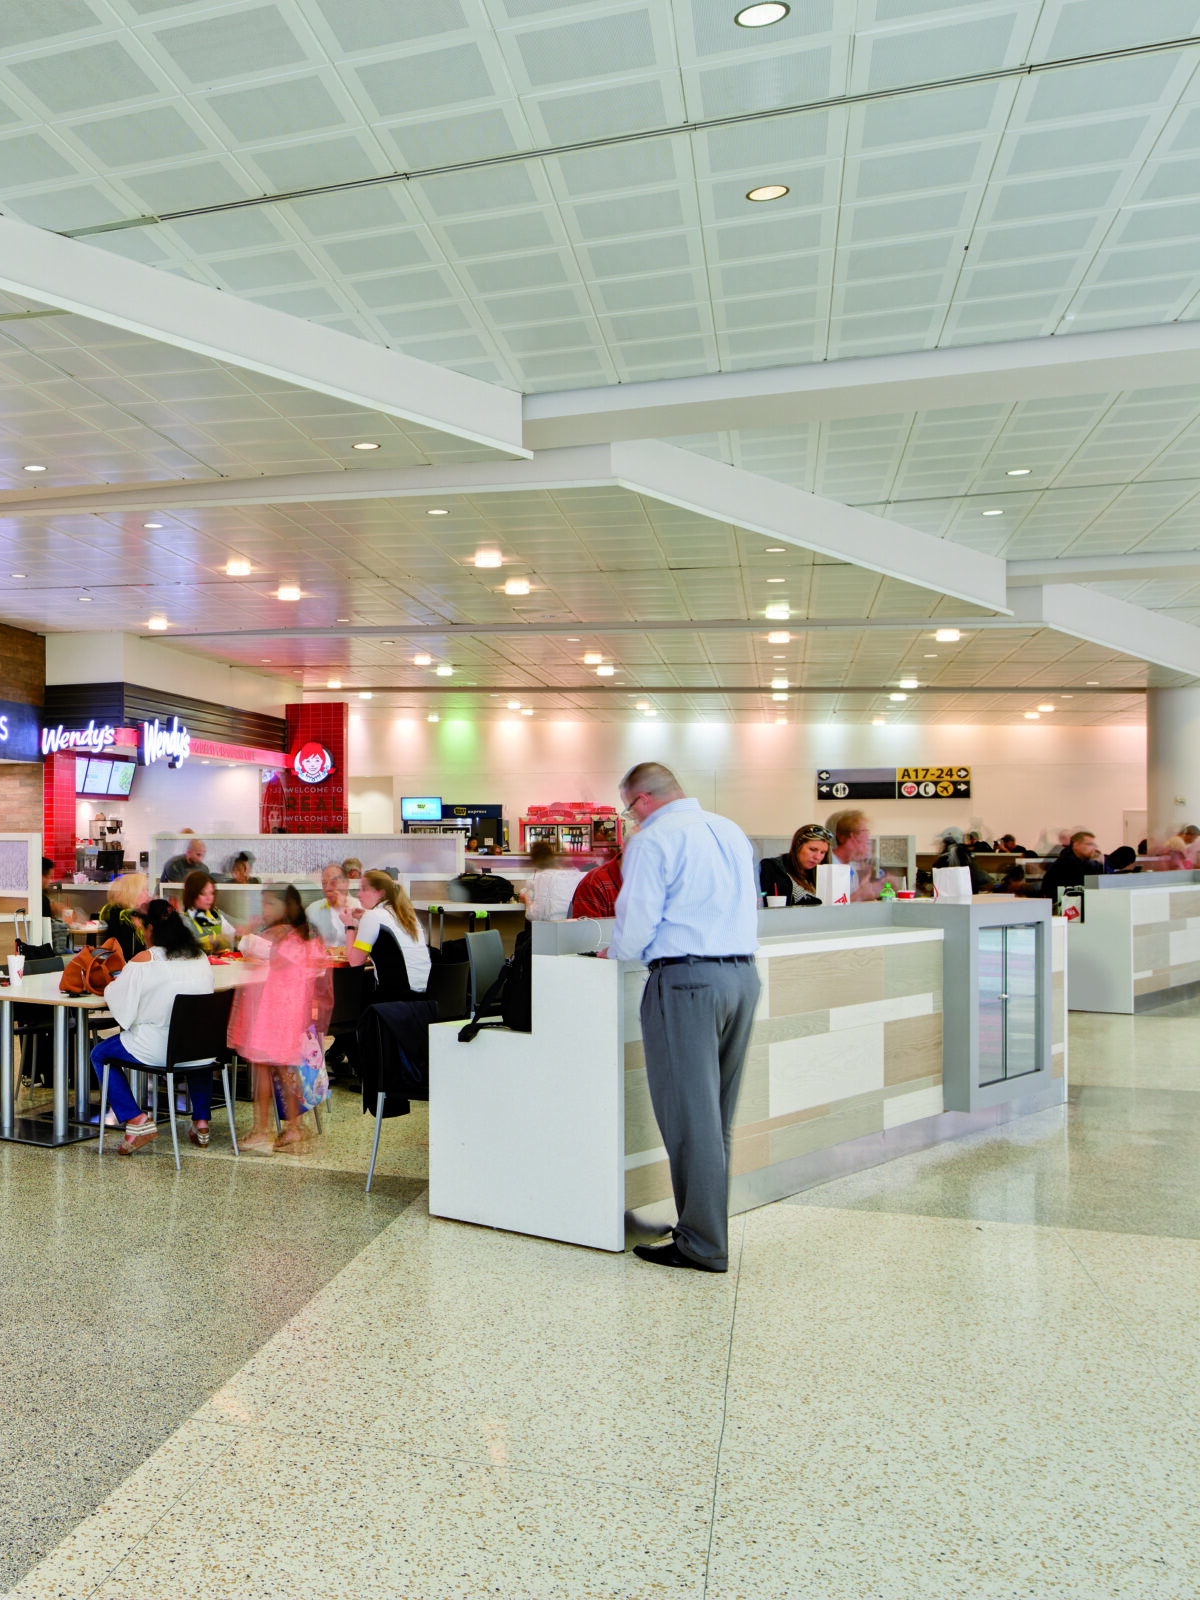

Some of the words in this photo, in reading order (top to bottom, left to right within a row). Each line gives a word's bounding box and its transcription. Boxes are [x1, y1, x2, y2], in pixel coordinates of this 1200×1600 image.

[41, 720, 116, 754] Wendy's
[143, 716, 191, 768] Wendy's
[901, 768, 954, 779] A17-24
[287, 797, 342, 812] REAL
